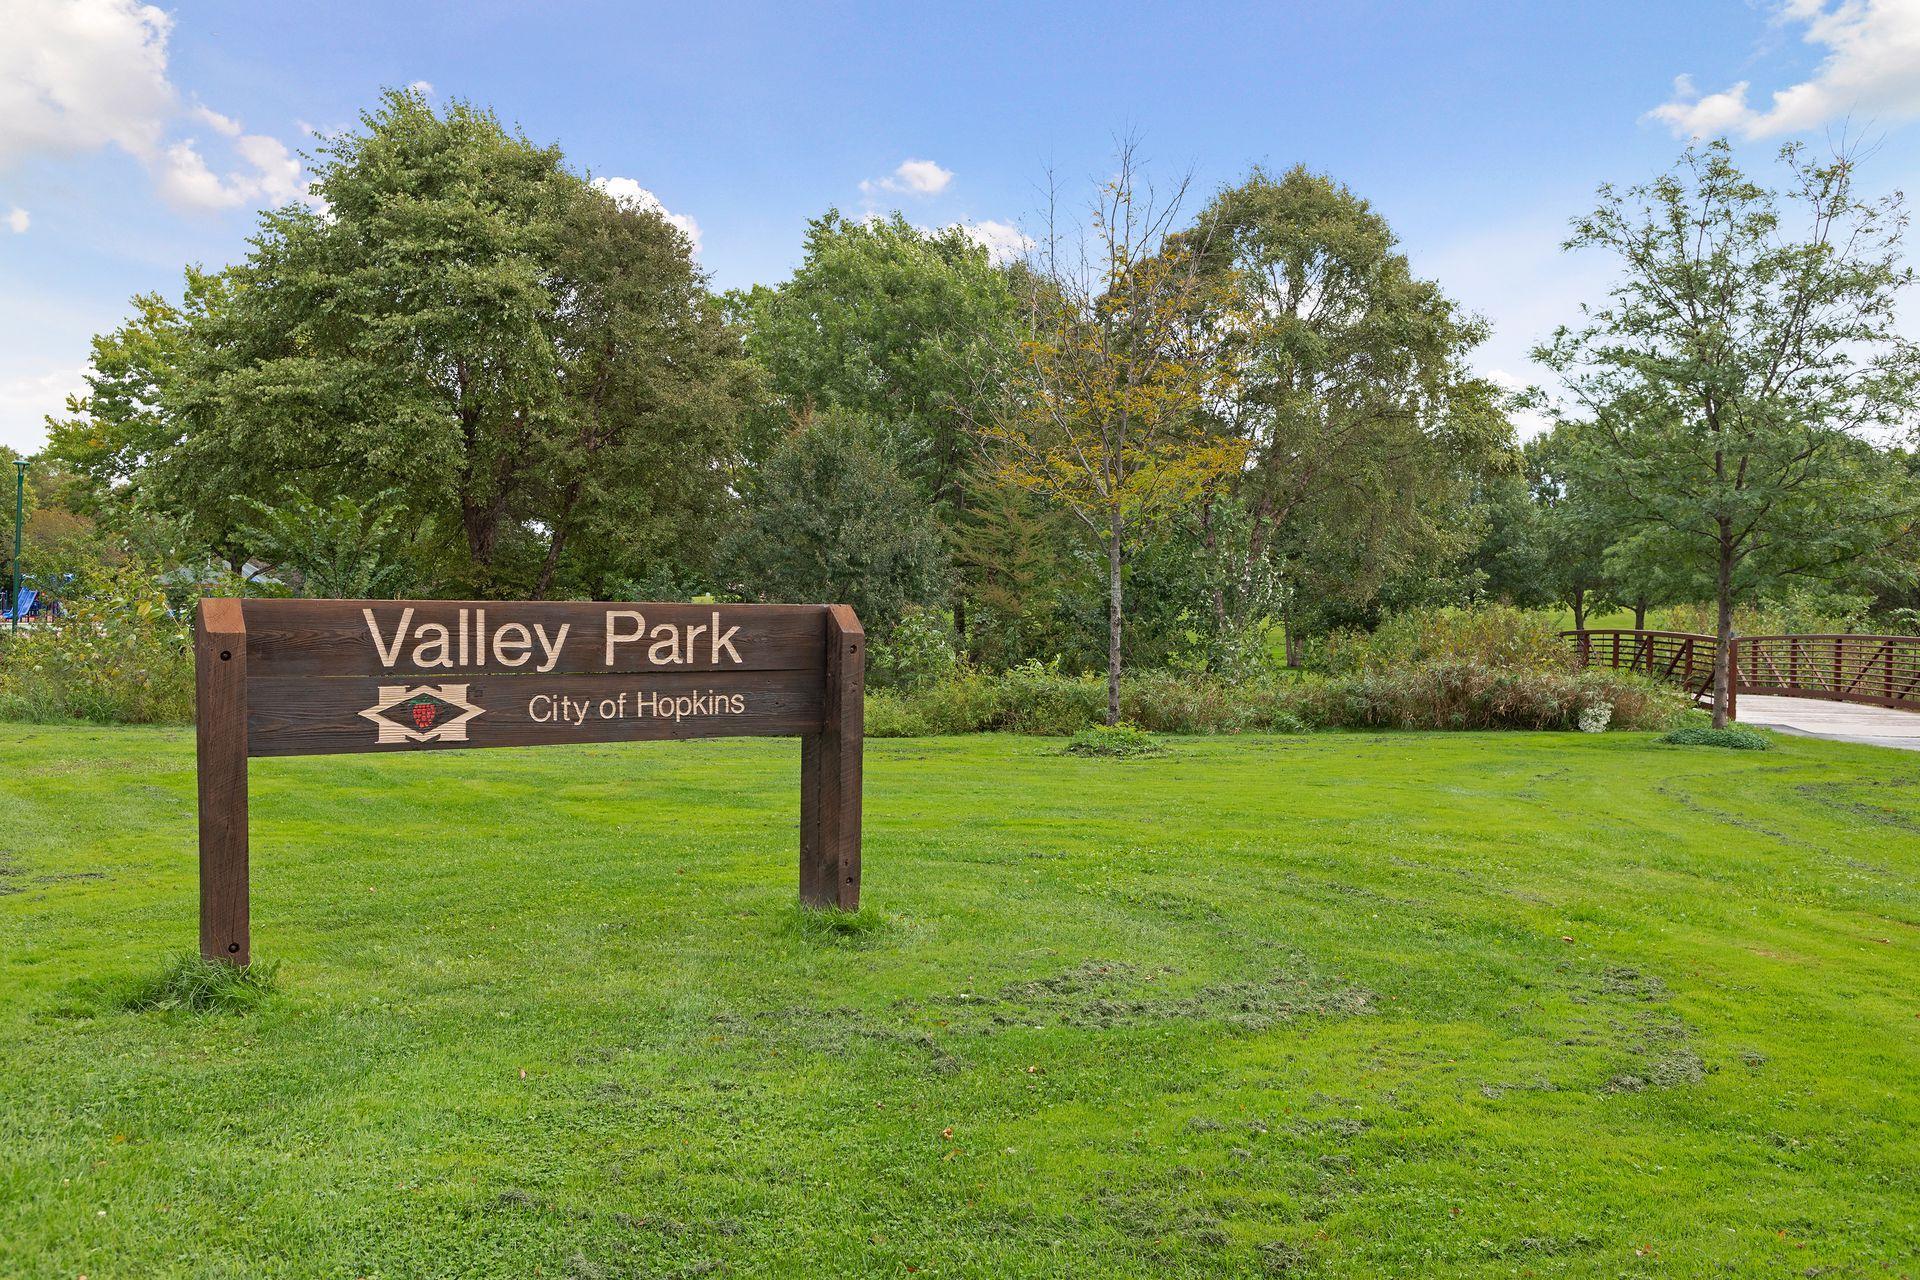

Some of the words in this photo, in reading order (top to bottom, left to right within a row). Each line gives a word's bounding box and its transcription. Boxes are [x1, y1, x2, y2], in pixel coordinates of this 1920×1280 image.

[362, 607, 571, 673] Valley
[605, 610, 743, 666] Park
[528, 694, 590, 726] City
[599, 692, 627, 720] of
[636, 689, 745, 723] Hopkins
